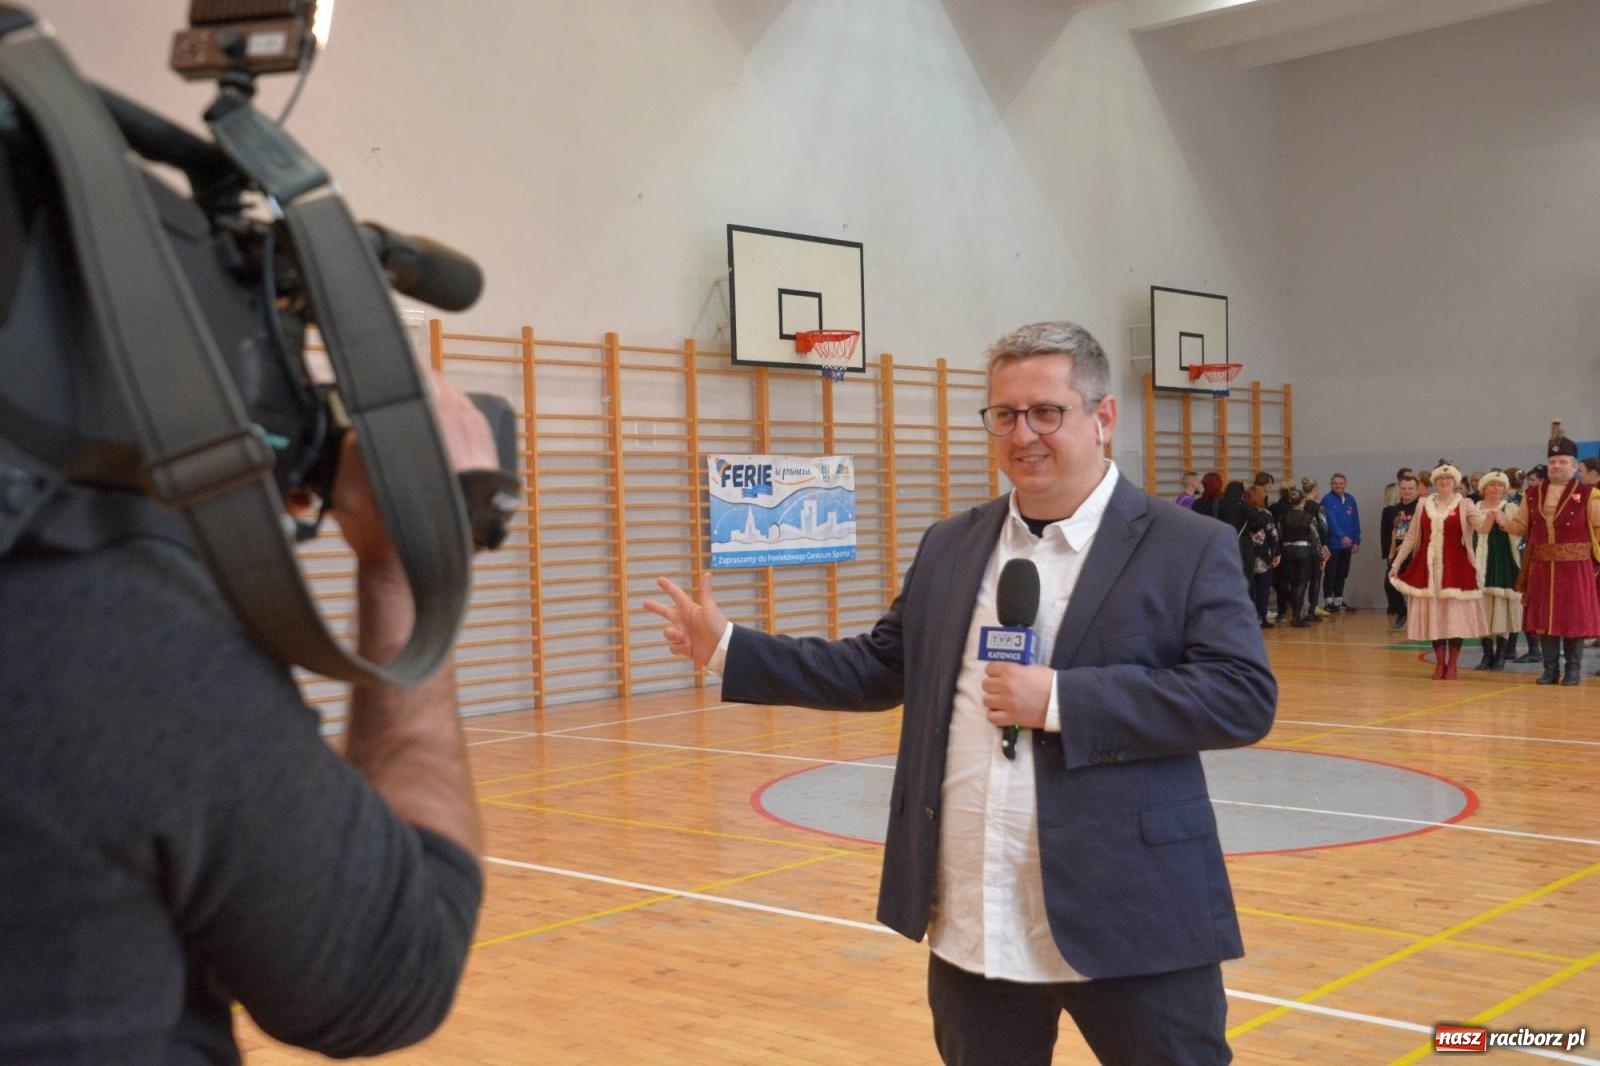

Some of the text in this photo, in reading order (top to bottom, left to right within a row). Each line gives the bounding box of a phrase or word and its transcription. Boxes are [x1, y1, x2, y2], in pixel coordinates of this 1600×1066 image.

[721, 464, 772, 487] FERIE
[718, 550, 850, 565] Zapraszamy do Powiatowego Centrum Sportu
